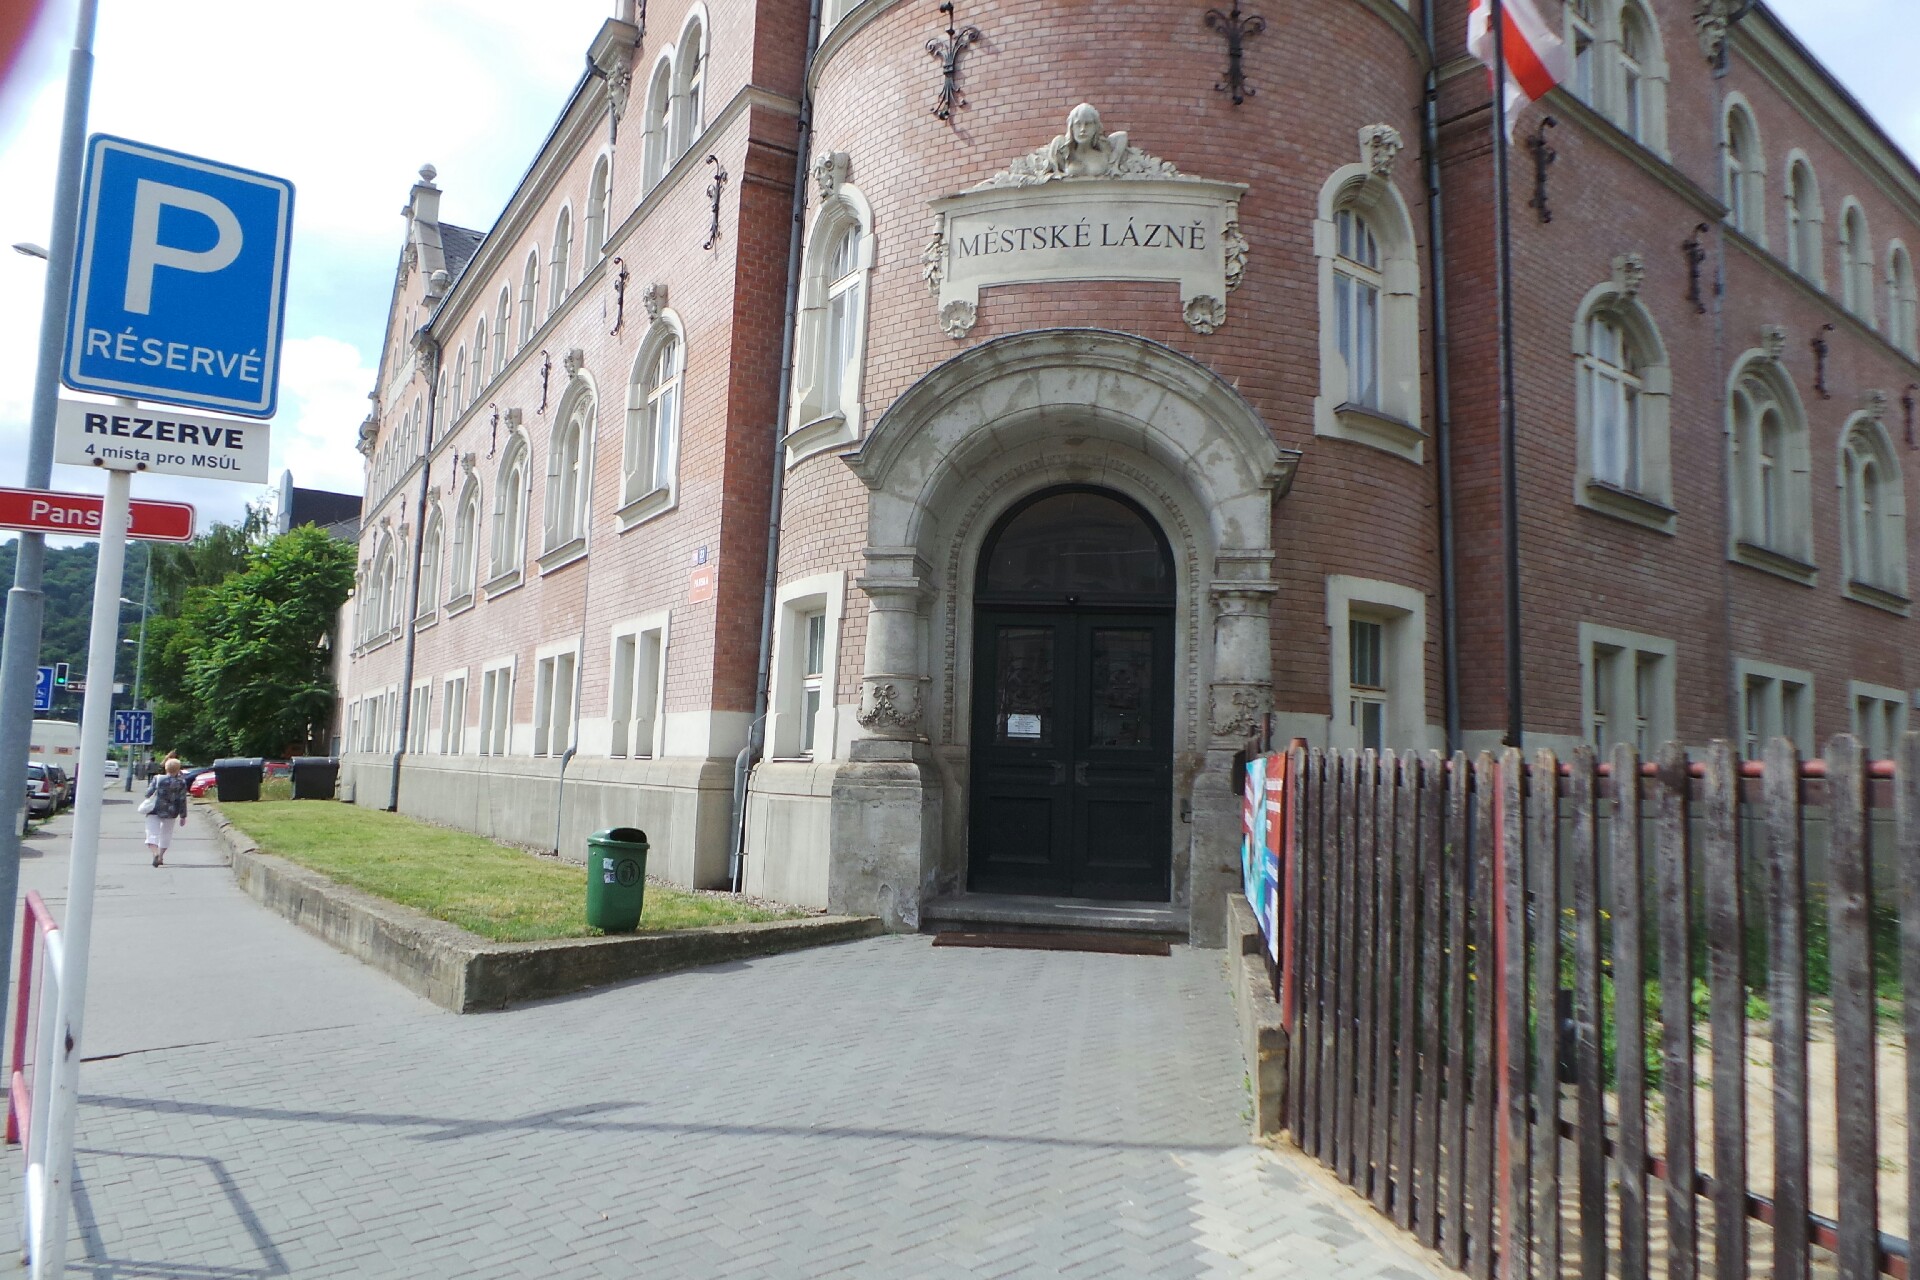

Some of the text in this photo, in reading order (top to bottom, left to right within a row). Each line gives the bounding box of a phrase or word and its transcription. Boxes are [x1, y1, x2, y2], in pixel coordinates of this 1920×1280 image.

[124, 178, 243, 315] P
[958, 217, 1206, 258] MĚSTSKÉ LÁZNĚ
[87, 326, 261, 383] RÉSERVÉ
[85, 413, 244, 449] REZERVE
[85, 444, 241, 471] 4 místa pro MSÚL
[31, 500, 134, 528] Pansá
